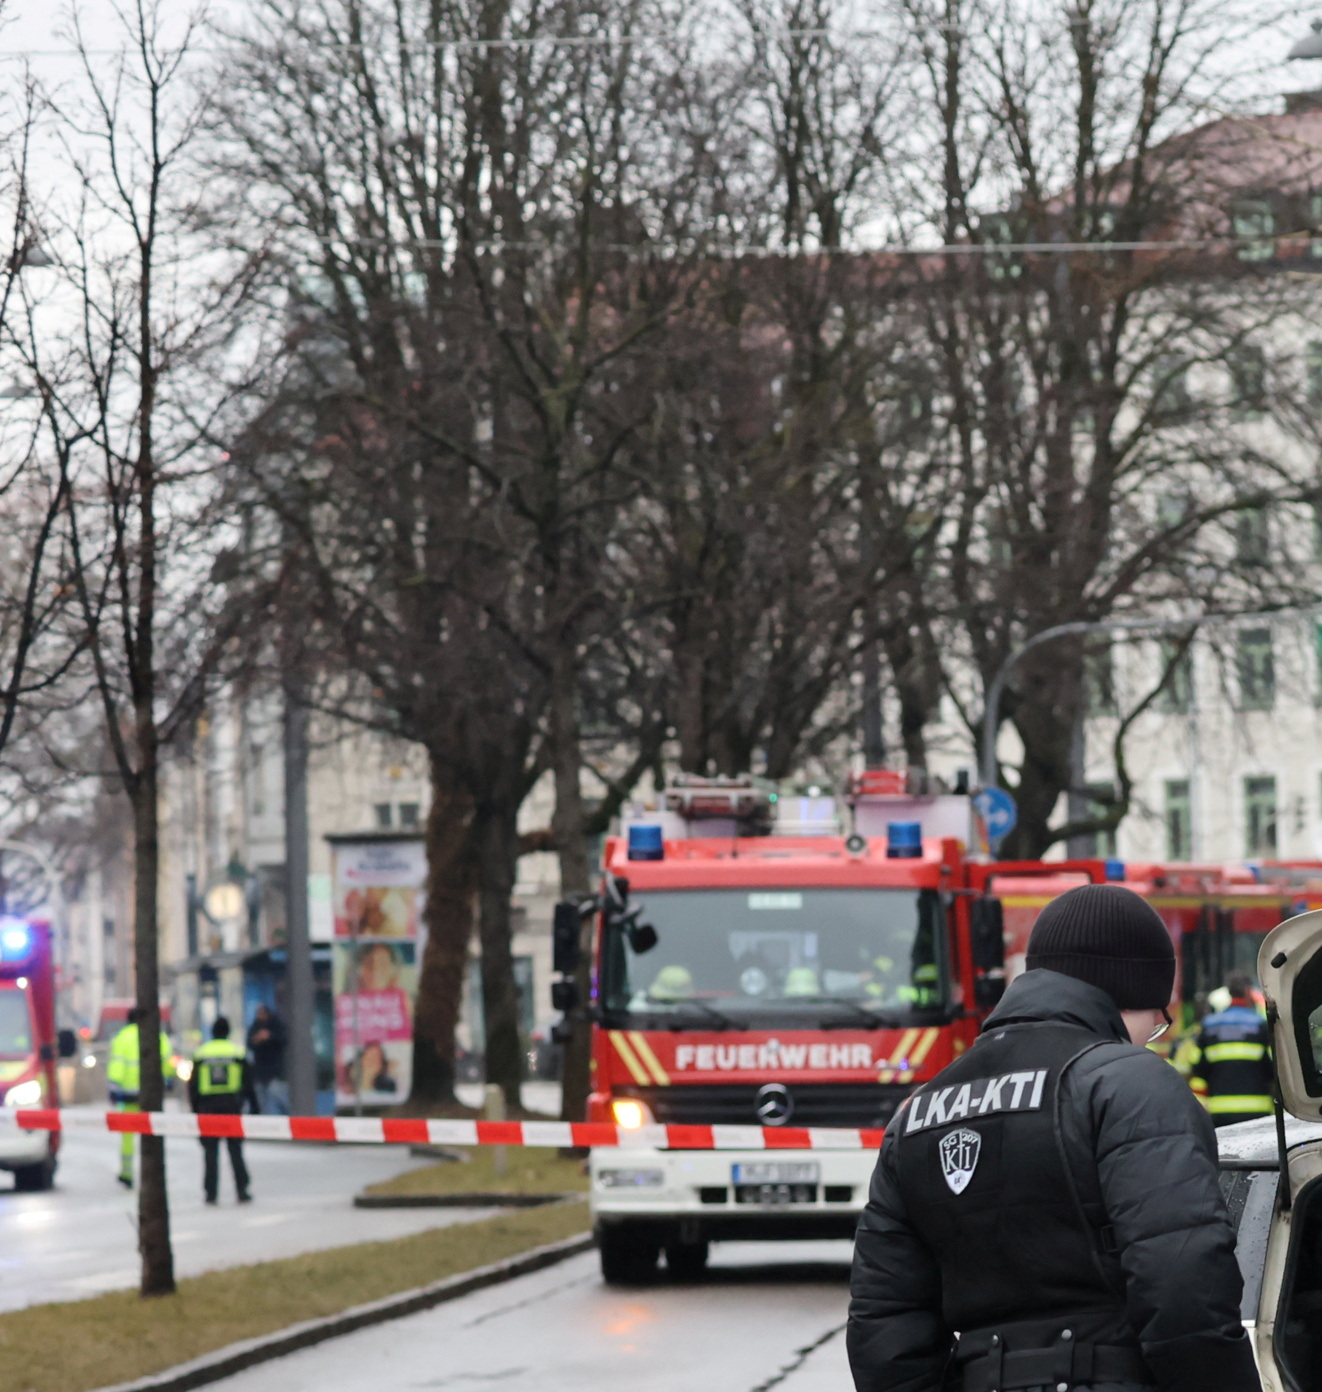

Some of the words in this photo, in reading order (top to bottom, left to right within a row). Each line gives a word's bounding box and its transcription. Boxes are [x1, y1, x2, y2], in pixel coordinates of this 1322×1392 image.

[675, 1043, 873, 1070] FEUERWEHR
[905, 1070, 1048, 1133] LKA-KTI
[943, 1135, 957, 1150] SG
[961, 1132, 979, 1144] 207
